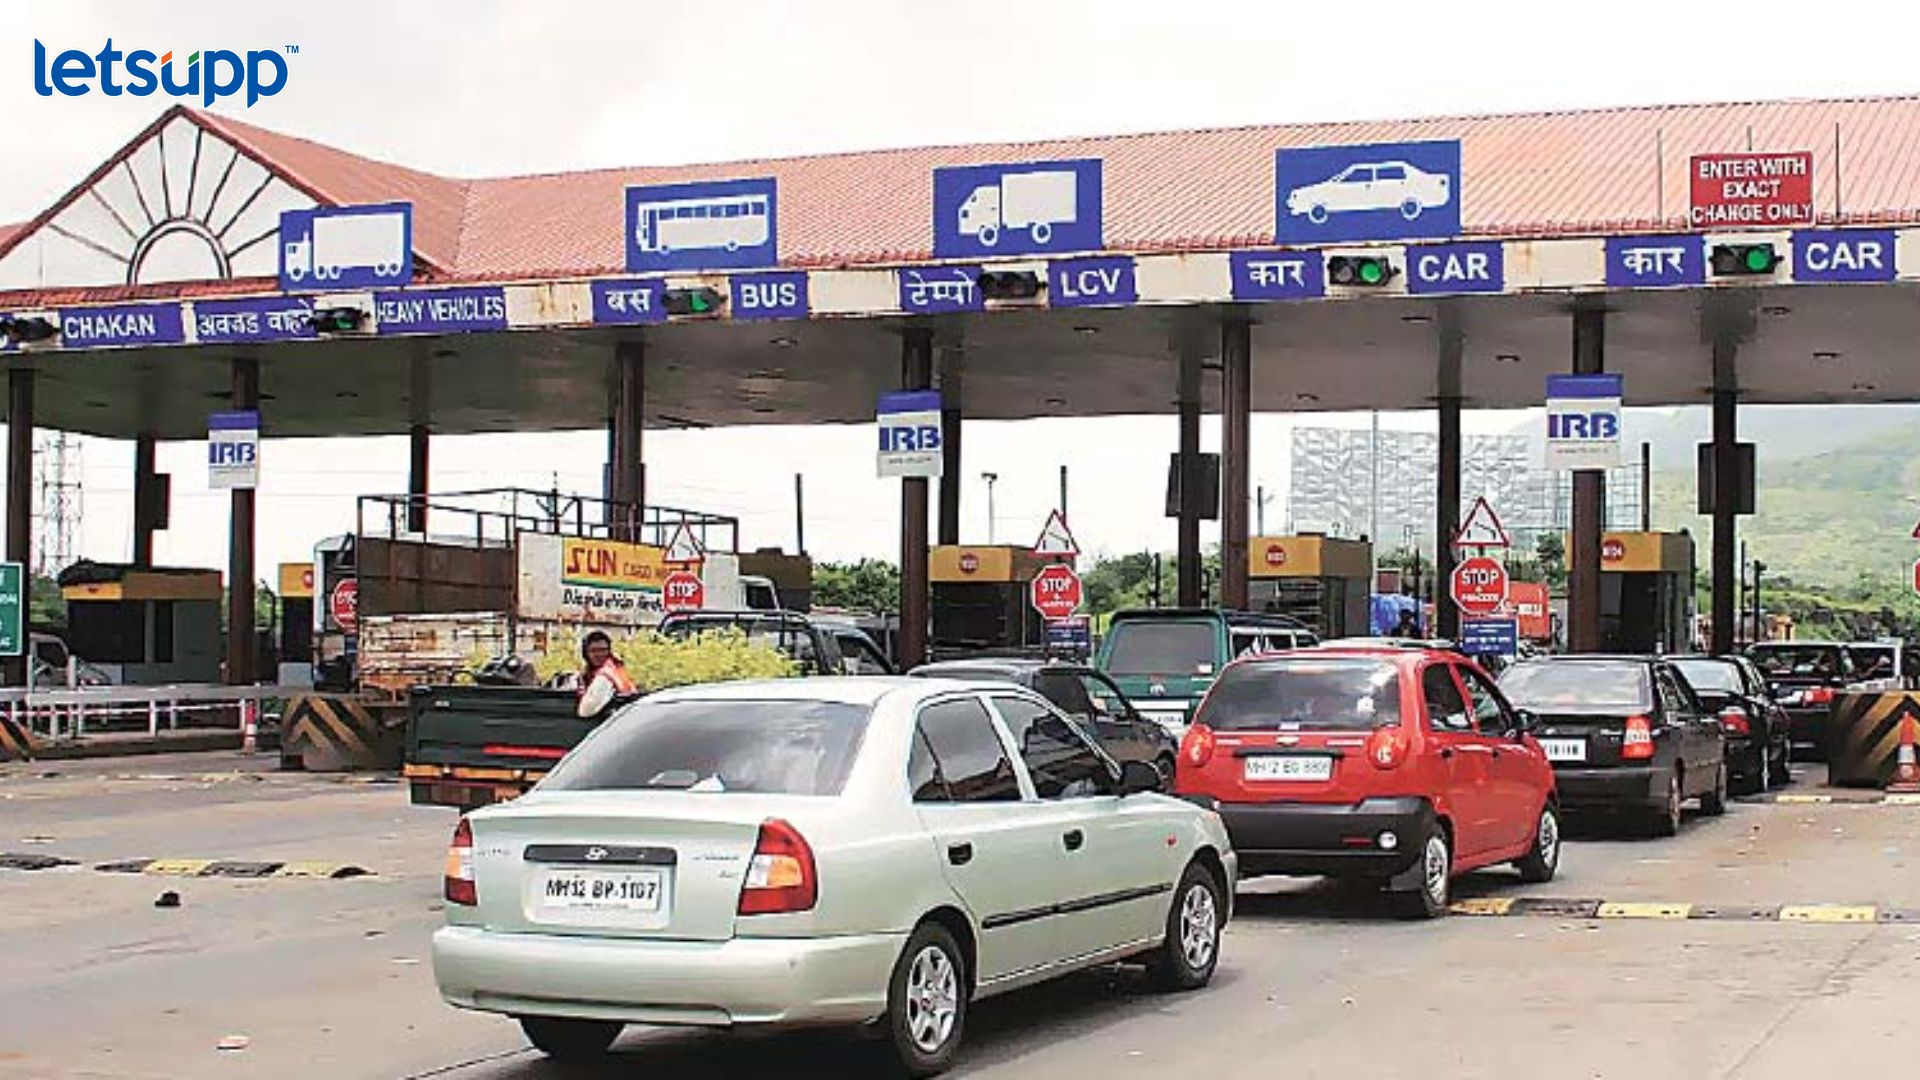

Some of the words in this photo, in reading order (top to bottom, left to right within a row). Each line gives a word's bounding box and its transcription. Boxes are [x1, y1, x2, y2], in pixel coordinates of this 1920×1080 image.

[1700, 160, 1757, 178] ENTER
[1760, 157, 1806, 176] WITH
[1722, 179, 1780, 198] EXACT
[1691, 204, 1763, 223] CHANGE
[1767, 203, 1812, 220] ONLY
[1418, 252, 1490, 281] CAR
[1621, 247, 1685, 275] कार
[1805, 241, 1883, 271] CAR
[1060, 268, 1121, 298] LCV
[1247, 260, 1305, 287] कार
[605, 288, 652, 313] बस
[740, 282, 796, 308] BUS
[376, 299, 424, 323] HEAVY
[427, 296, 503, 321] VEHICLES
[65, 314, 156, 339] CHAKAN
[1548, 412, 1618, 438] IRB
[879, 426, 941, 451] IRB
[208, 442, 256, 464] IRB
[567, 547, 616, 576] SUN
[1041, 577, 1072, 594] STOP
[1461, 568, 1499, 585] STOP
